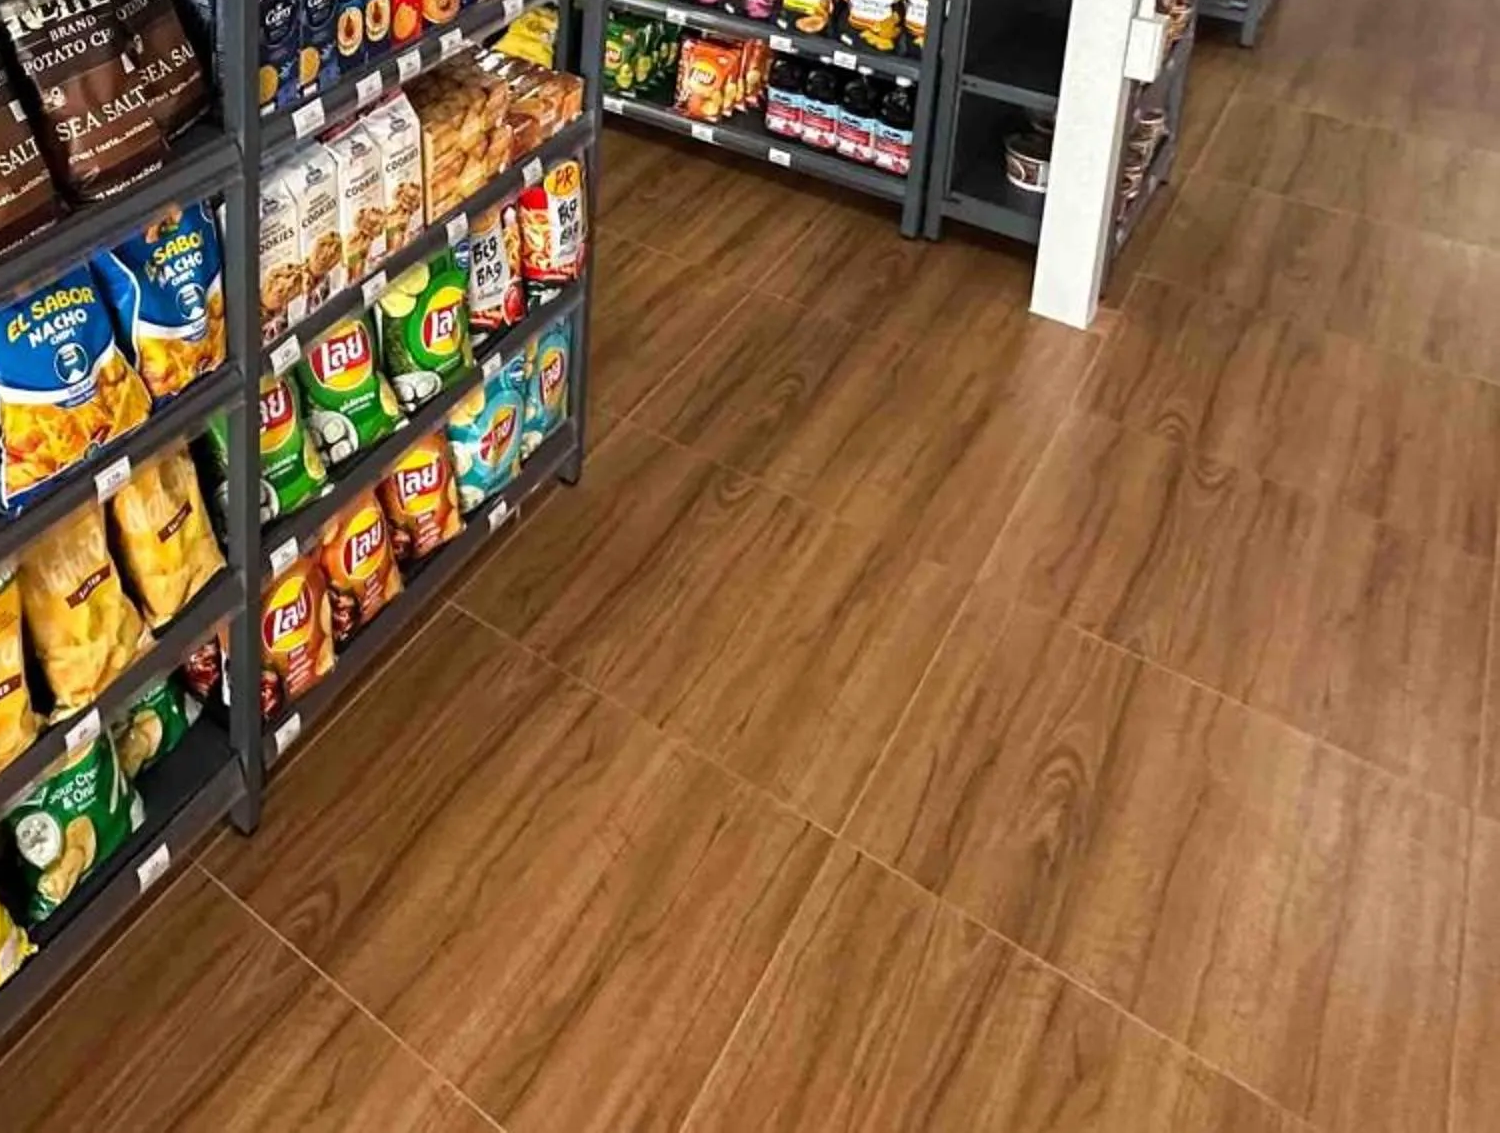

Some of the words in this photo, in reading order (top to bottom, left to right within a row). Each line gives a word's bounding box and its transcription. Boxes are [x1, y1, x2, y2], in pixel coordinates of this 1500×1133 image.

[49, 14, 98, 43] BRAND
[21, 39, 88, 76] POTATO
[55, 111, 102, 143] SEA
[101, 85, 149, 124] SALT
[153, 231, 203, 265] SABO
[260, 227, 296, 255] OOKIES
[6, 313, 31, 343] EL
[30, 286, 97, 321] SABOR
[27, 308, 89, 348] NACHO
[75, 767, 99, 786] Cre
